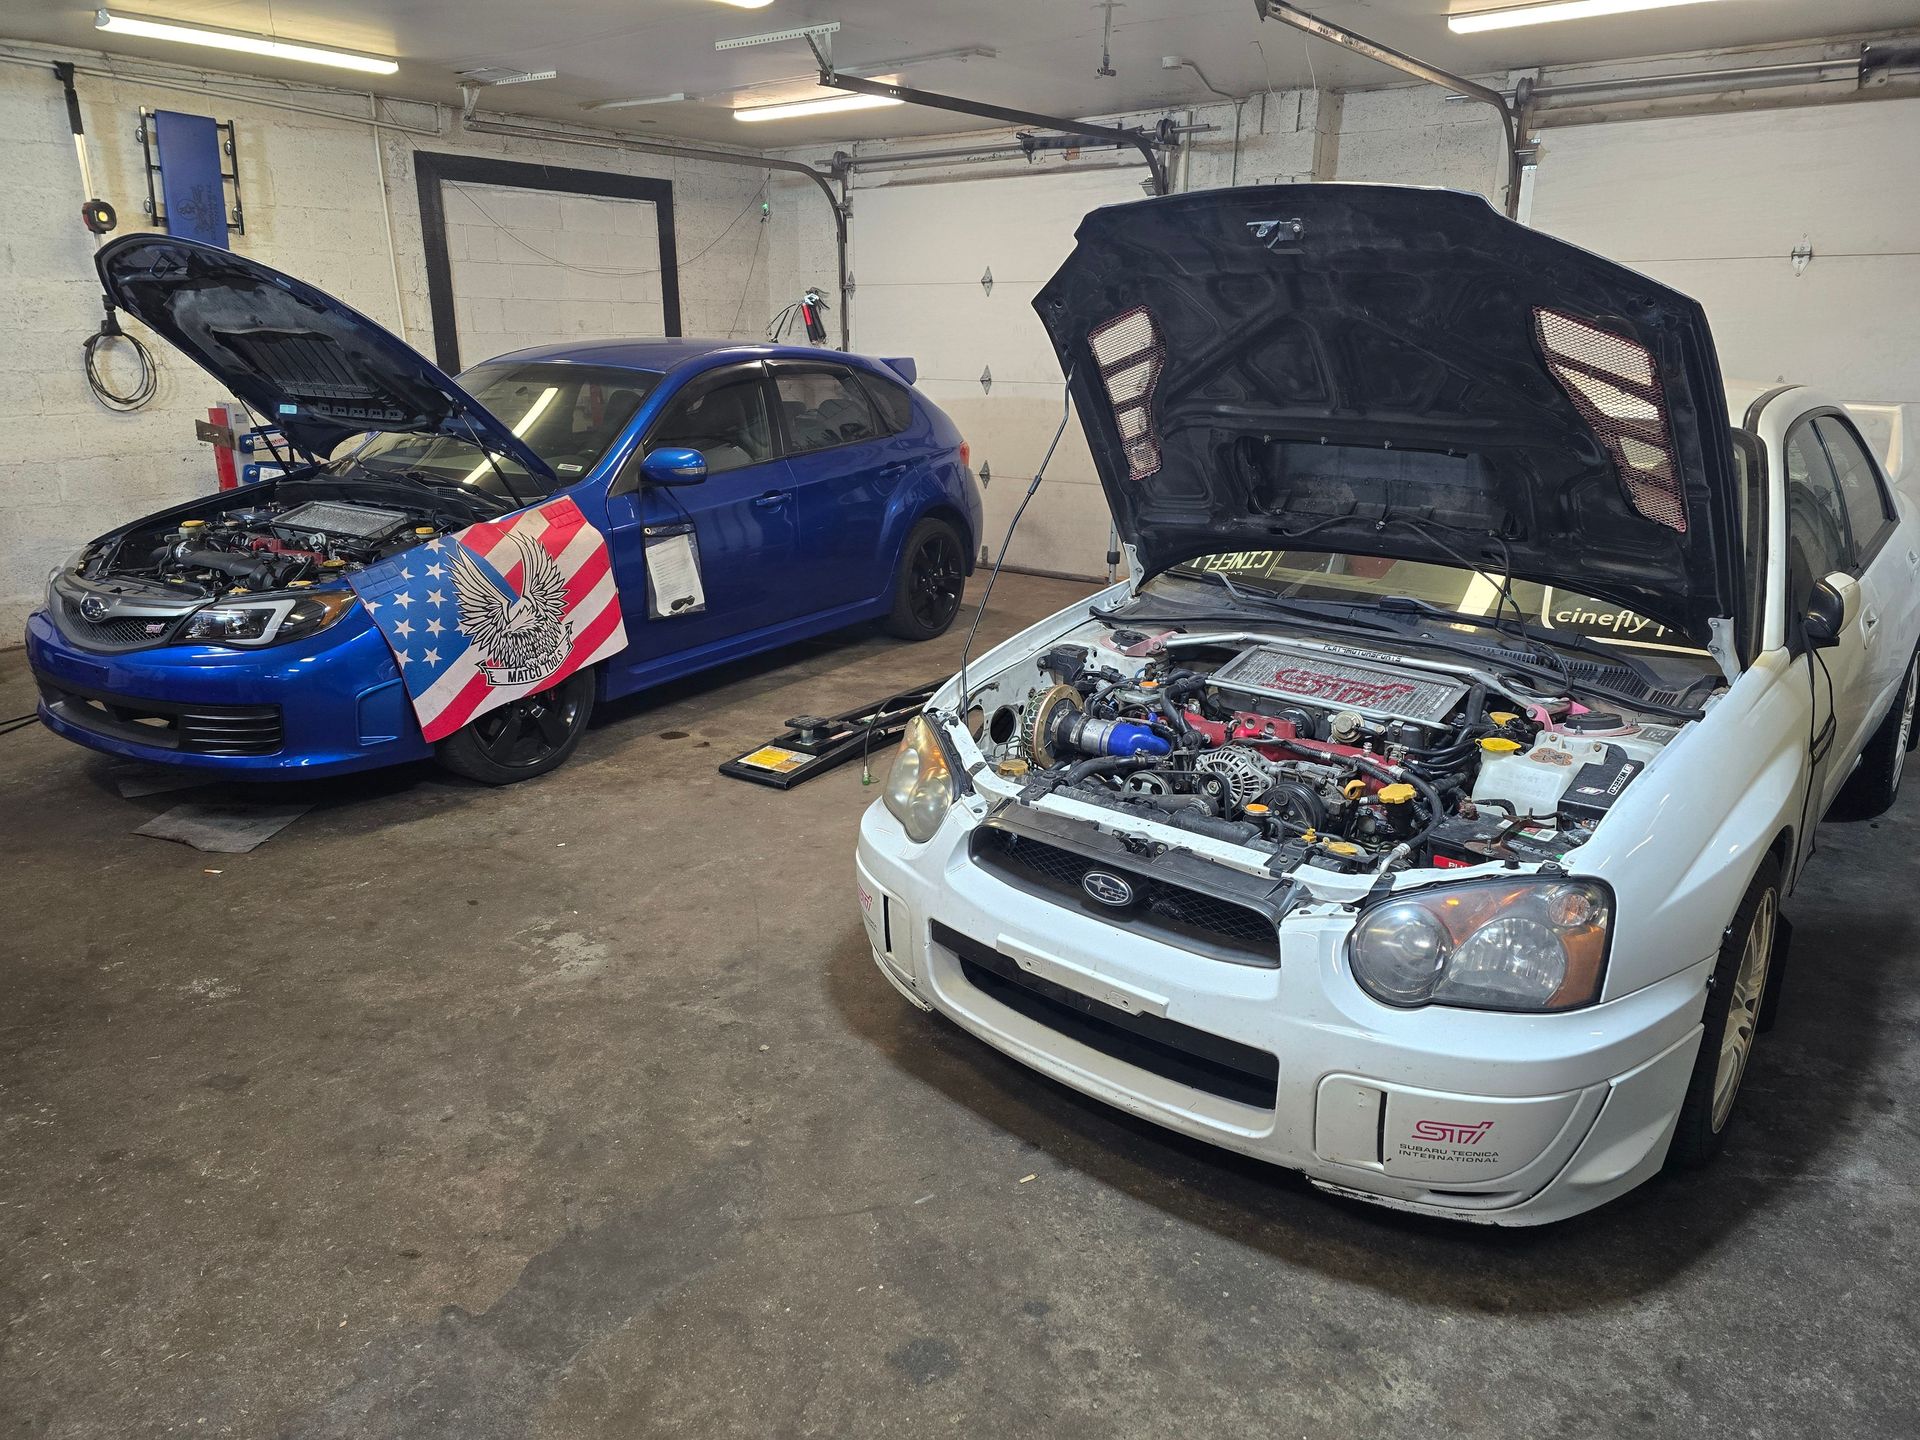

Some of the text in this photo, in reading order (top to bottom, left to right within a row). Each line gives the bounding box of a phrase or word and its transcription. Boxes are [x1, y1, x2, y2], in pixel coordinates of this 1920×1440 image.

[1556, 607, 1650, 634] cinefly
[508, 649, 564, 683] MATCO TOOLS
[1398, 1149, 1500, 1164] INTERNATIONAL
[1399, 1143, 1500, 1158] SUBARU TECNICA
